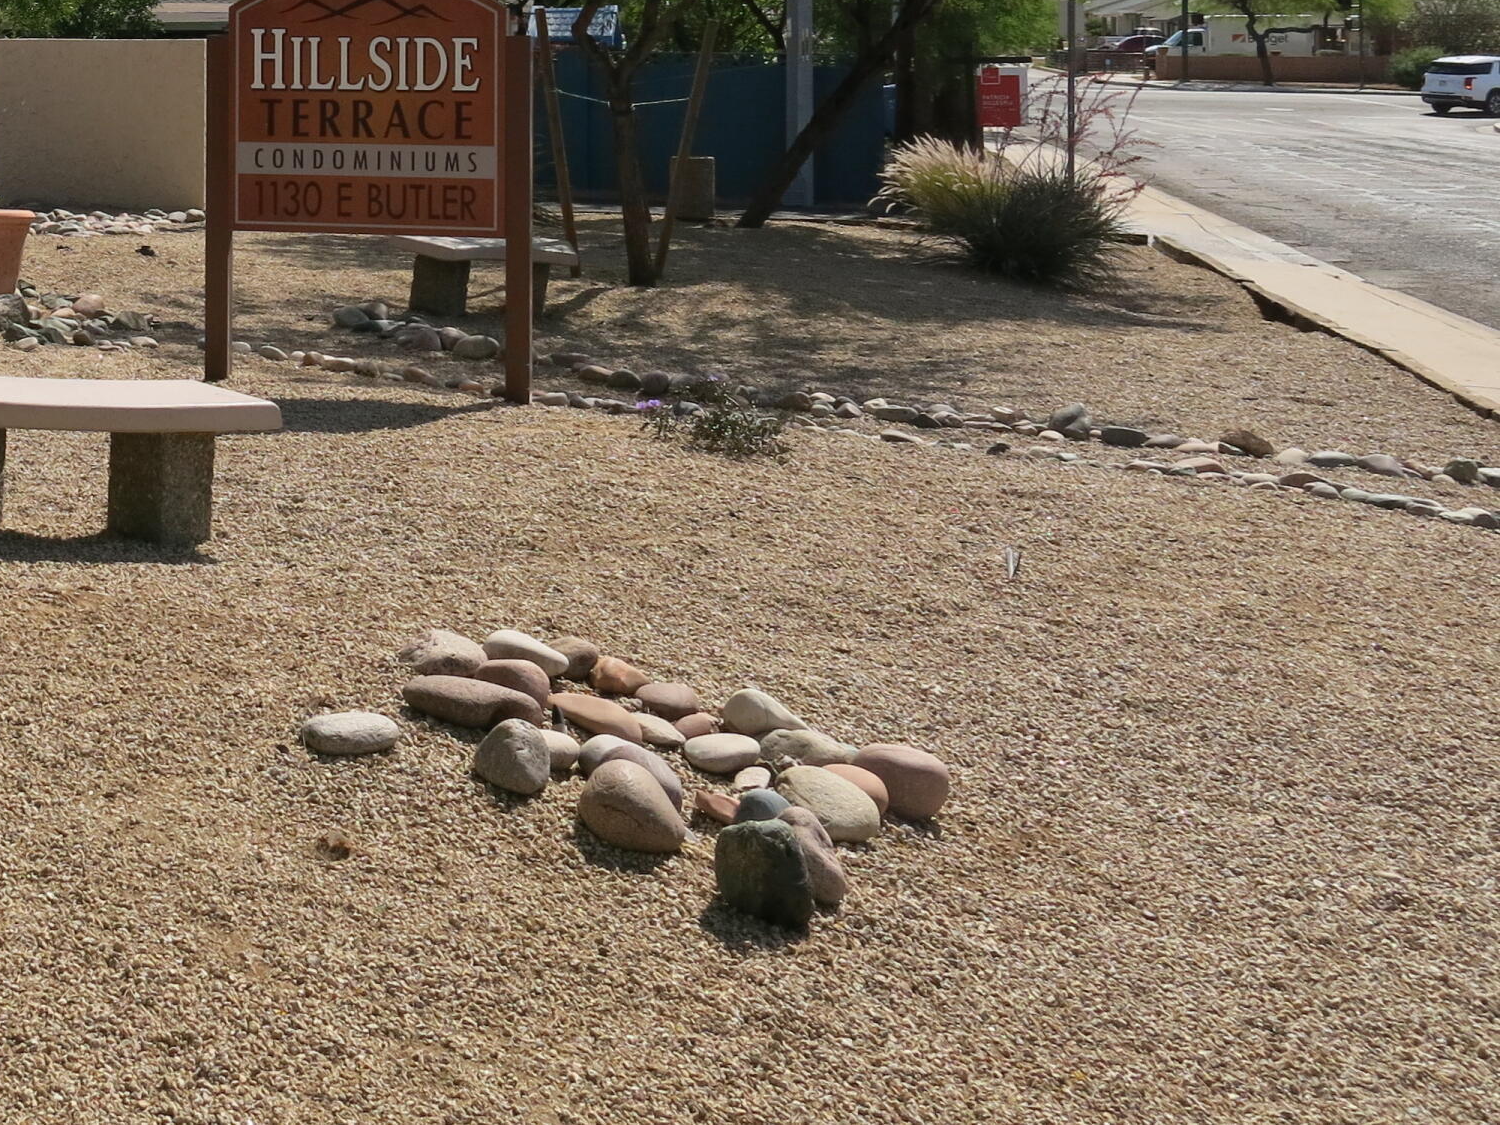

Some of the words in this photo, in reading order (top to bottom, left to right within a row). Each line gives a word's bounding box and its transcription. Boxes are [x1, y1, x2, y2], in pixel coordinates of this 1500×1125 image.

[250, 28, 481, 92] HILLSIDE
[260, 99, 473, 140] TERRACE
[254, 148, 478, 173] CONDOMINIUMS
[254, 181, 323, 217] 1130
[336, 182, 353, 217] E
[367, 183, 477, 221] BUTLER
